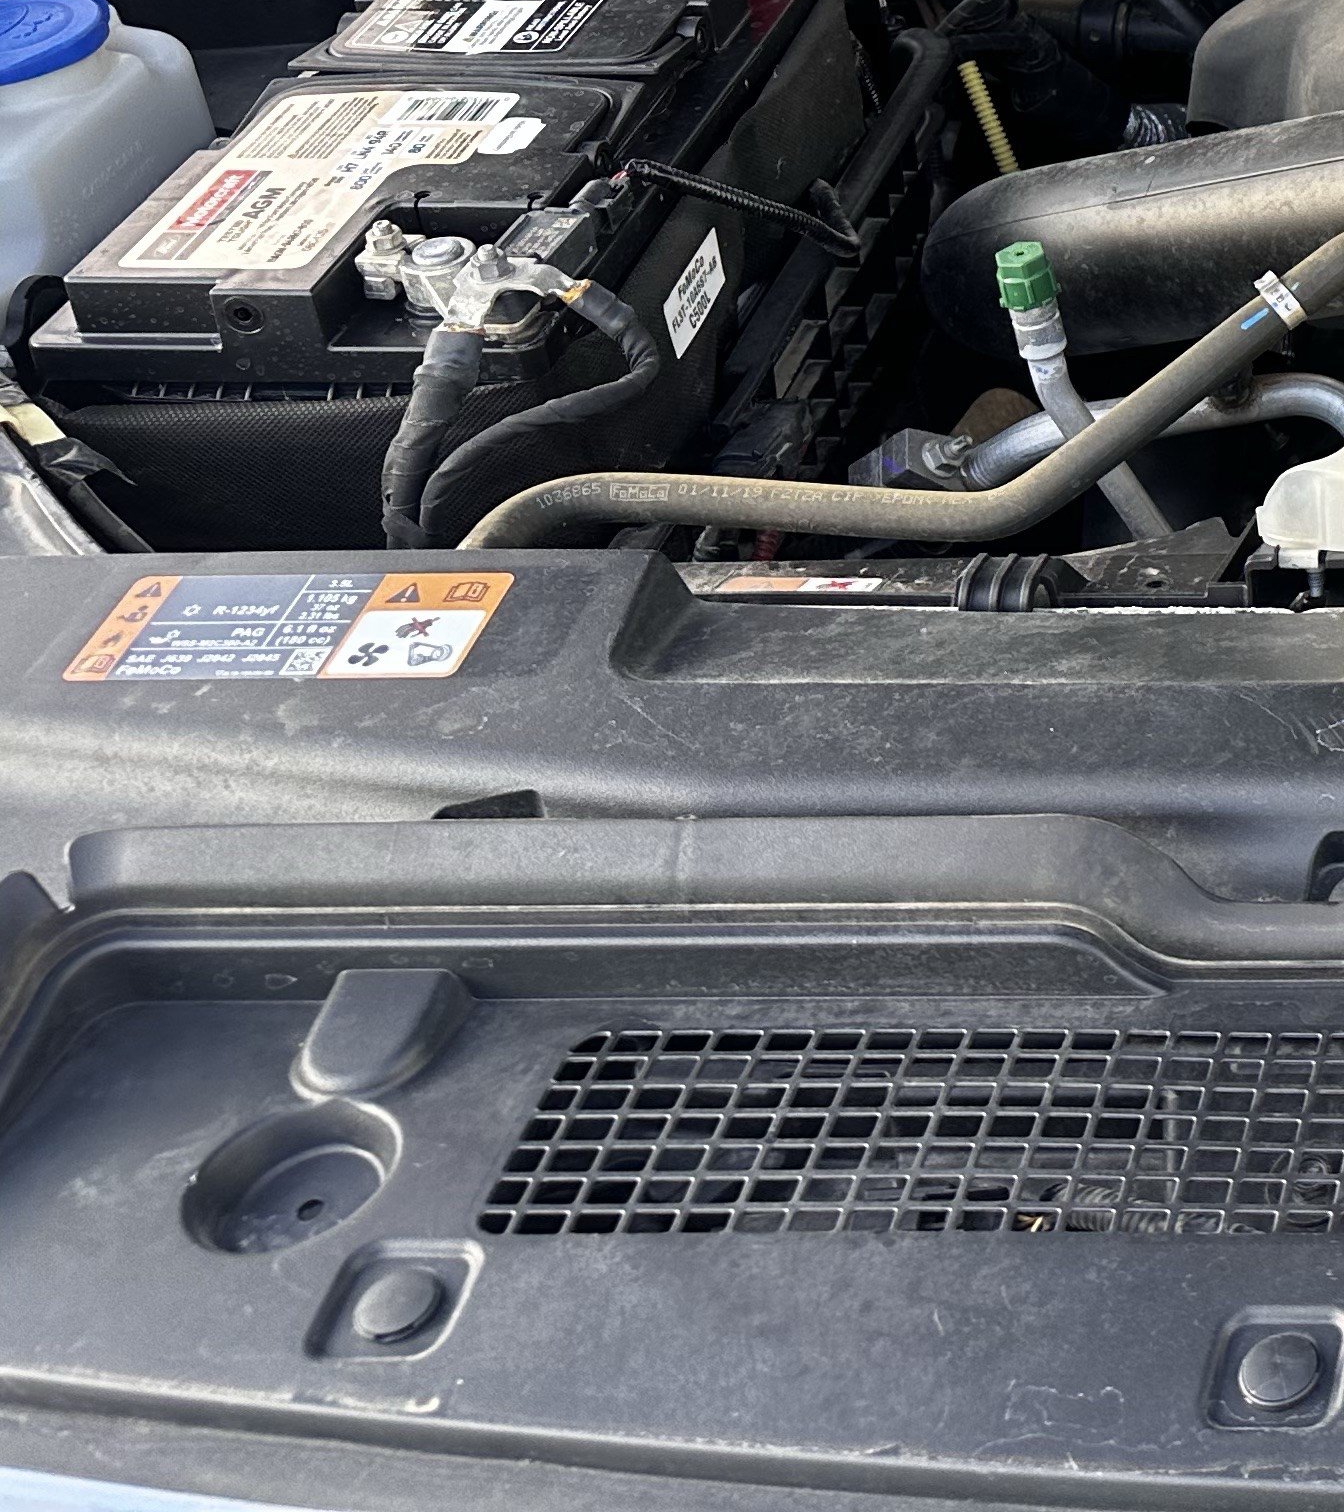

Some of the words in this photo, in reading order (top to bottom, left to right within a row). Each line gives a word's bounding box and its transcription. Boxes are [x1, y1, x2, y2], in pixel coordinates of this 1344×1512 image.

[182, 175, 245, 227] Motorcraft
[242, 188, 287, 220] AGM
[611, 484, 668, 500] FoMoCo
[678, 484, 762, 498] 01/11/19
[212, 604, 280, 616] R-1234yf
[231, 627, 266, 637] PAG
[125, 654, 156, 663] SAE
[115, 664, 182, 676] FoMoCo
